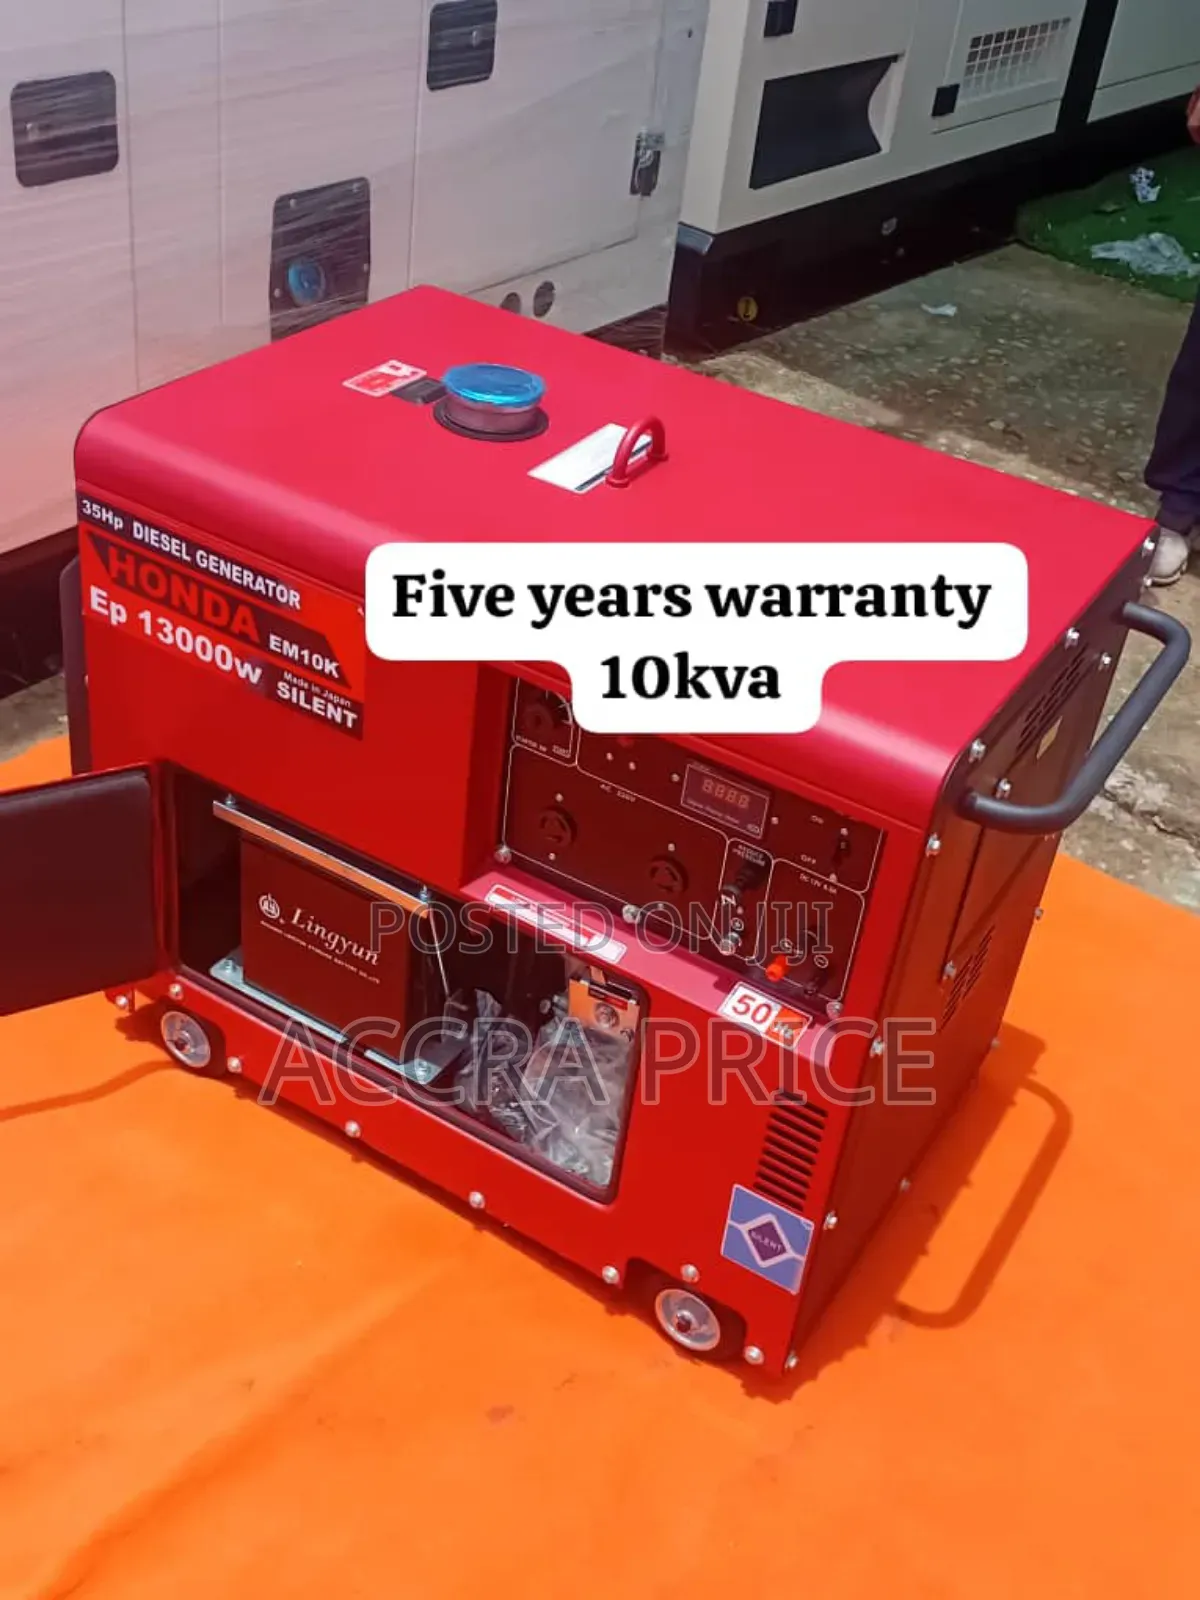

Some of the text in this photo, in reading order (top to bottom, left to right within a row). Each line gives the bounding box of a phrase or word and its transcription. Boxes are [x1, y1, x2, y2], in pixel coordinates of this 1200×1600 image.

[82, 500, 301, 610] 35Hp DIESEL GENERATOR
[108, 546, 261, 642] HONDA
[90, 585, 261, 684] Ep 13000w
[269, 634, 340, 678] EM10K
[277, 681, 358, 728] SILENT
[291, 907, 379, 966] Lingyun
[732, 994, 773, 1024] 50
